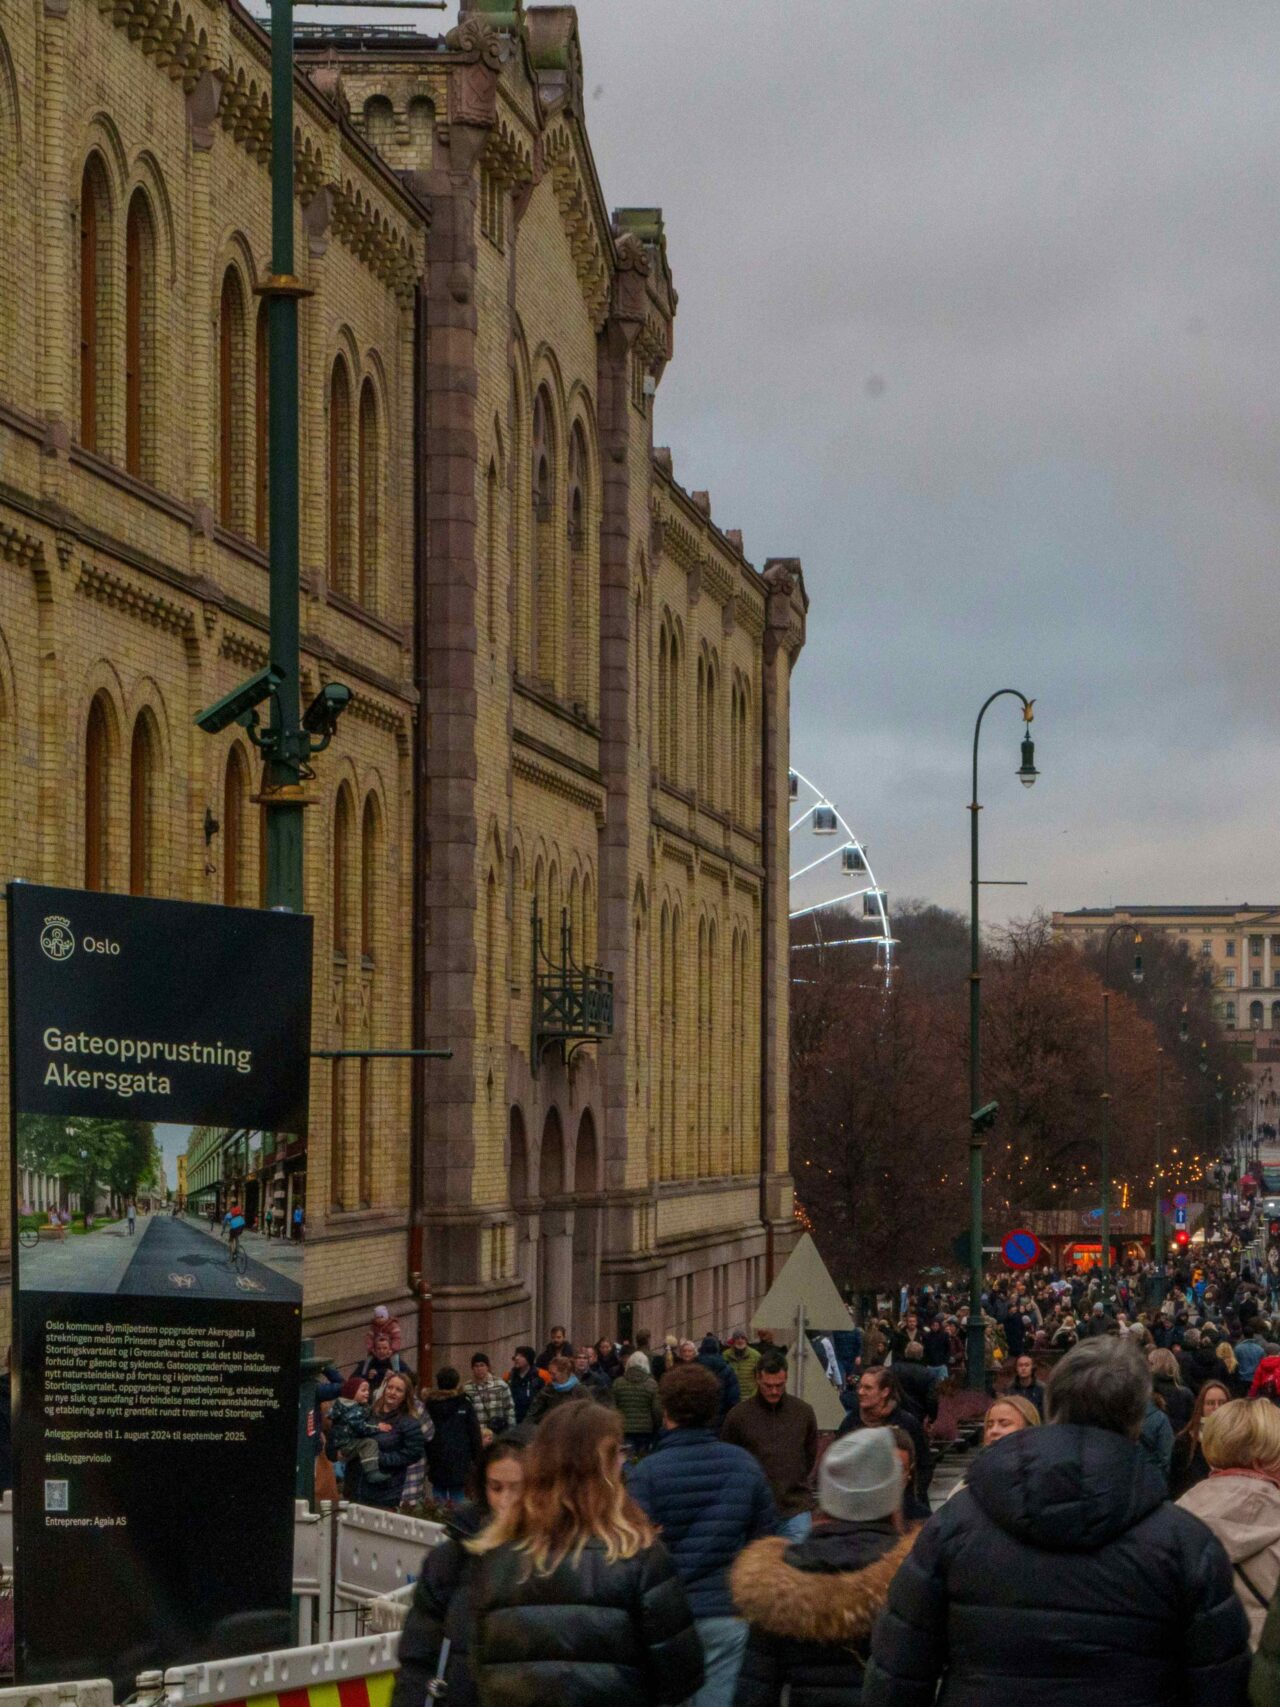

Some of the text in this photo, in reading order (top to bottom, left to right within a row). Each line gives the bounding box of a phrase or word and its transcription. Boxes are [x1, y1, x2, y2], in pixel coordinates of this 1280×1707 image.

[83, 937, 121, 955] Oslo
[43, 1028, 251, 1073] Gateopprustning
[43, 1063, 171, 1097] Akersgata
[46, 1321, 255, 1339] Oslo kommune Bymiljøetaten oppgraderer Akersgata på
[46, 1334, 92, 1344] strekningen
[94, 1335, 122, 1344] mellom
[125, 1336, 157, 1345] Prinsens
[158, 1338, 175, 1348] gate
[177, 1340, 186, 1349] og
[46, 1345, 117, 1356] Stortingskvartalet
[118, 1349, 128, 1358] og
[133, 1347, 198, 1359] Grensenkvartalet
[202, 1350, 217, 1360] skal
[218, 1351, 231, 1360] det
[232, 1351, 242, 1360] bli
[243, 1352, 265, 1361] bedre
[46, 1357, 280, 1373] forhold for gående og syklende. Gateoppgraderingen inkluderer
[45, 1370, 61, 1380] nytt
[63, 1370, 125, 1380] natursteindekke
[126, 1371, 136, 1381] på
[137, 1371, 160, 1381] fortau
[162, 1374, 172, 1383] og
[177, 1372, 219, 1383] kjørebanen
[45, 1381, 117, 1392] Stortingskvartalet,
[119, 1384, 170, 1395] oppgradering
[182, 1385, 235, 1396] gatebelysning,
[236, 1387, 274, 1397] etablering
[55, 1395, 69, 1404] nye
[70, 1394, 86, 1403] sluk
[88, 1396, 98, 1405] og
[99, 1395, 134, 1406] sandfang
[139, 1395, 182, 1405] forbindelse
[184, 1397, 200, 1405] med
[45, 1406, 55, 1416] og
[55, 1406, 95, 1416] etablering
[107, 1408, 122, 1417] nytt
[124, 1408, 158, 1417] grøntfelt
[160, 1408, 181, 1417] rundt
[182, 1409, 209, 1417] trærne
[210, 1409, 224, 1417] ved
[225, 1409, 265, 1420] Stortinget.
[45, 1429, 247, 1442] Anleggsperiode til 1. august 2024 til september 2025.
[45, 1453, 112, 1464] #slikbyggervioslo
[45, 1516, 92, 1528] Entreprenør:
[116, 1517, 127, 1526] AS
